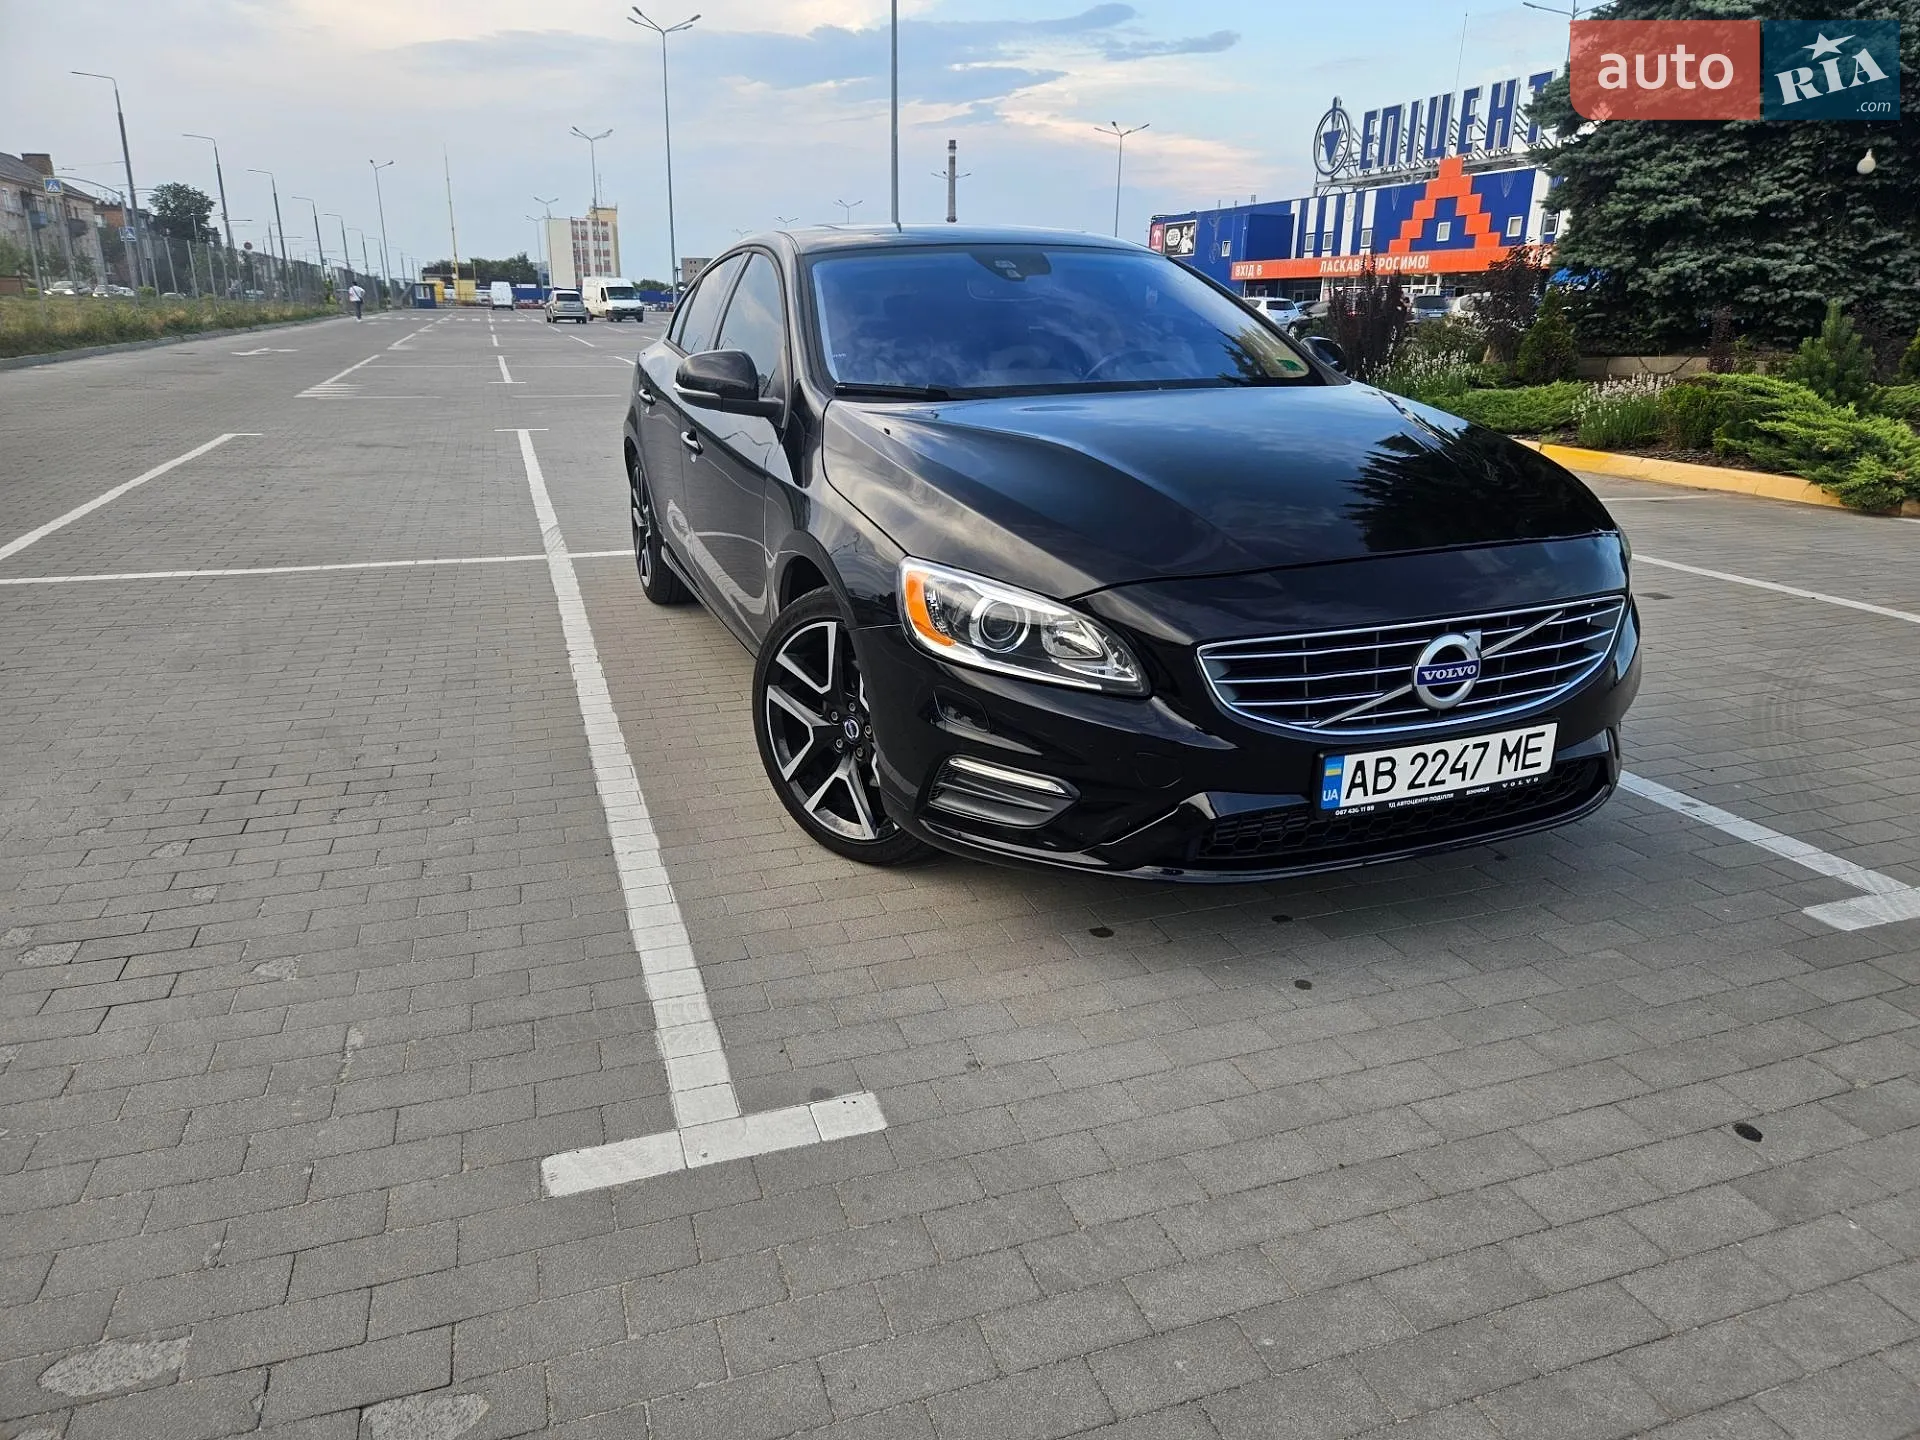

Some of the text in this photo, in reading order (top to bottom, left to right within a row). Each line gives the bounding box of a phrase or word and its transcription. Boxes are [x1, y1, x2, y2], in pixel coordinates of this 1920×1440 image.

[1421, 664, 1477, 681] VOLVO
[1344, 731, 1546, 800] AB 2247 ME
[1322, 788, 1339, 802] UA
